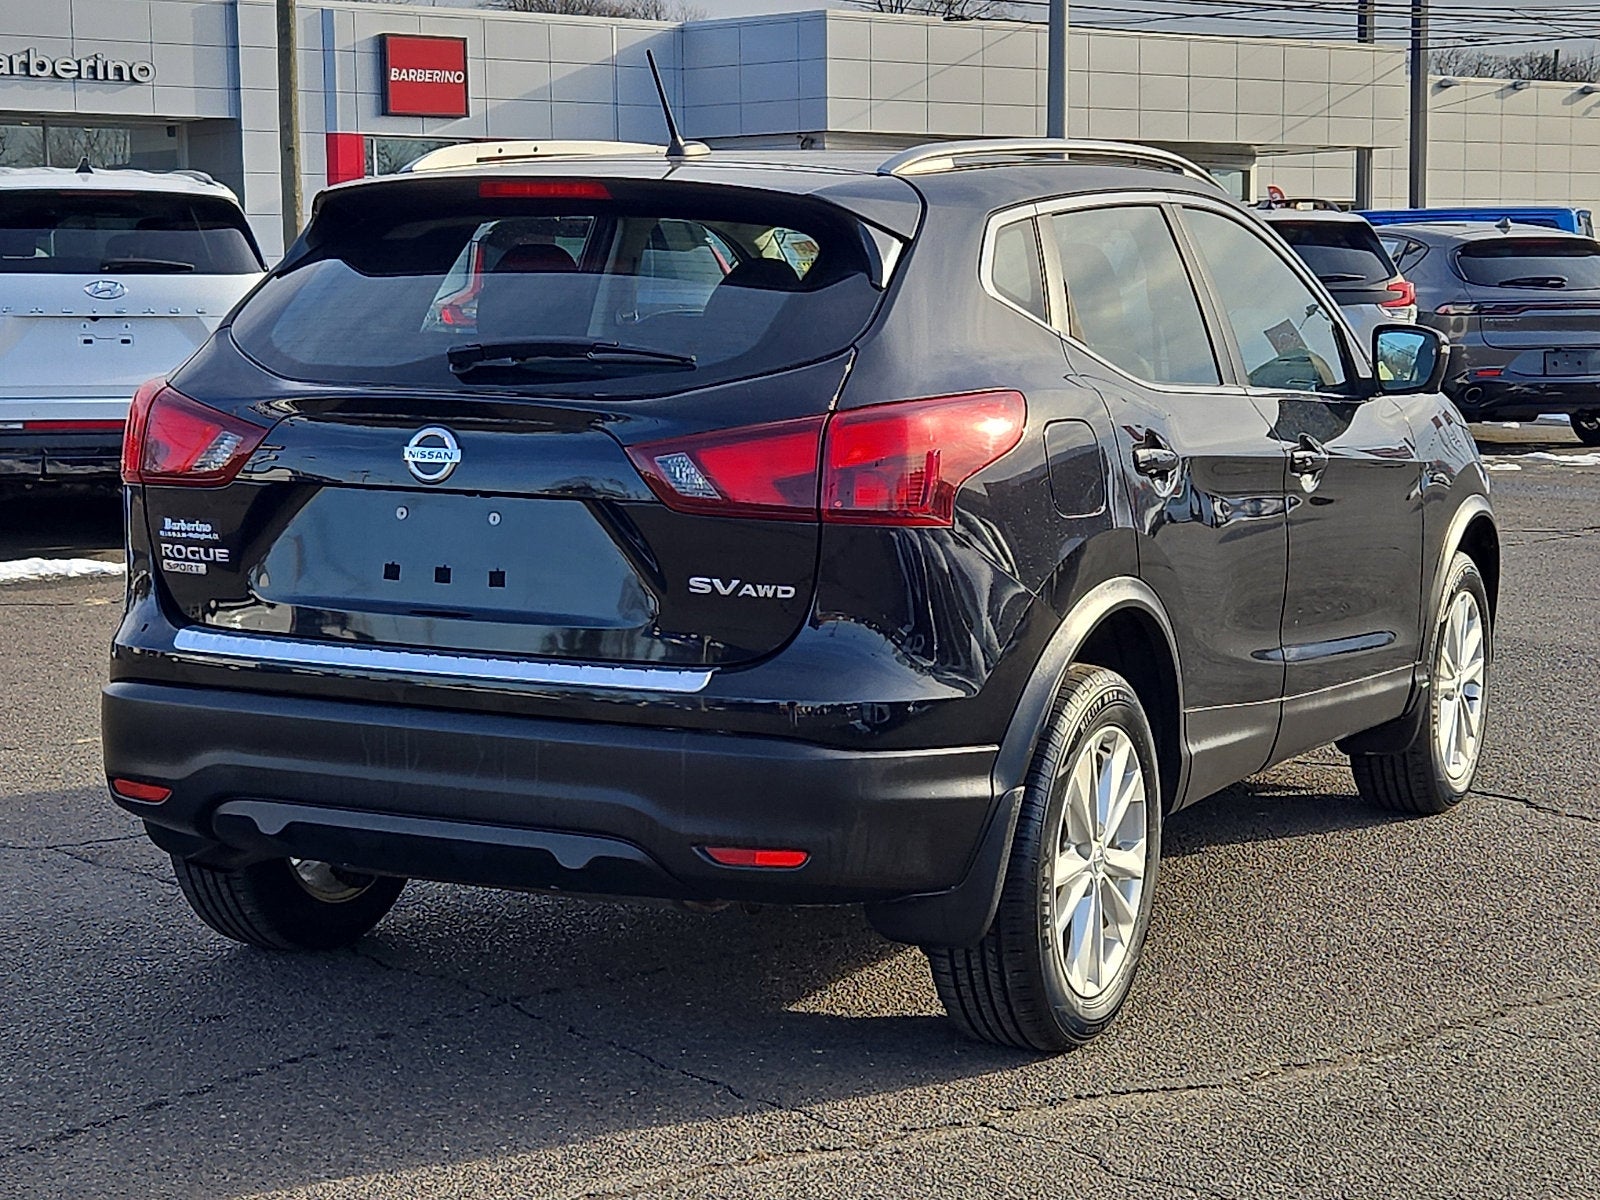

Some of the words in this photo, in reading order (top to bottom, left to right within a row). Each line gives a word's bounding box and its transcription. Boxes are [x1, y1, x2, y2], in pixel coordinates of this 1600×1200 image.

[390, 67, 465, 84] BARBERINO
[407, 450, 453, 461] NISSAN
[163, 517, 212, 532] Barberino
[160, 543, 229, 562] ROGUE
[165, 561, 201, 573] SPORT
[688, 577, 740, 596] SV
[737, 583, 796, 598] AWD
